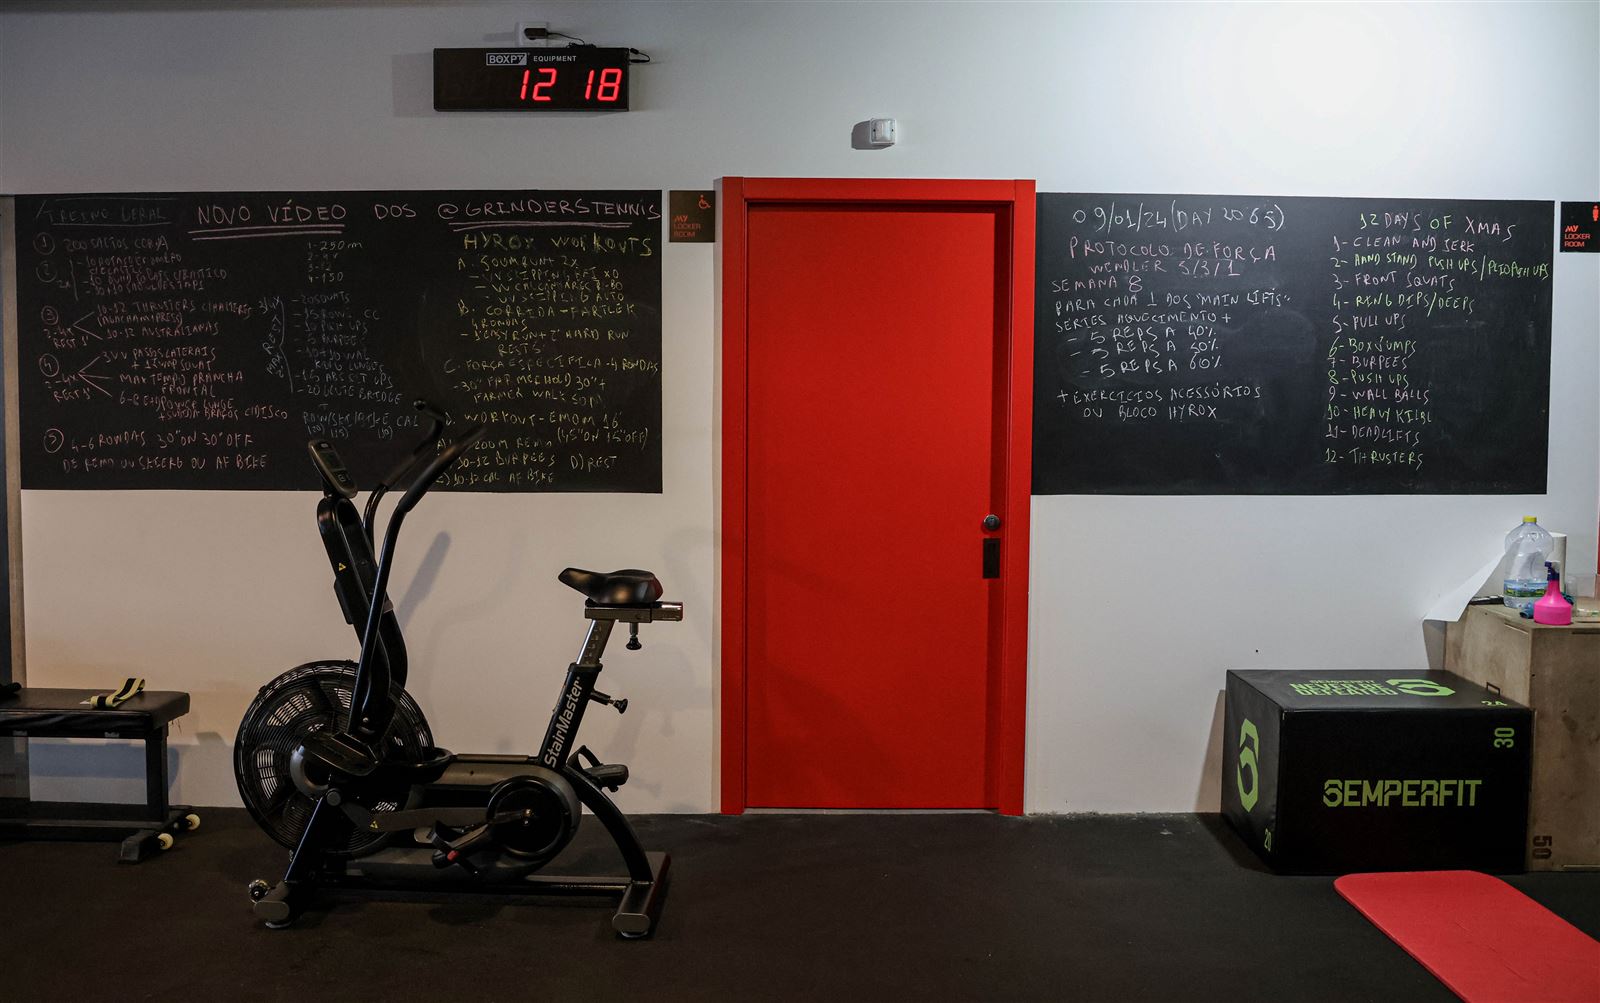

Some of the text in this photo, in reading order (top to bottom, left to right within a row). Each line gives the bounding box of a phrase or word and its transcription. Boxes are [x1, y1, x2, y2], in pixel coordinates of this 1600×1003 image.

[487, 53, 527, 65] BOXPT
[519, 68, 622, 101] 12 18
[198, 198, 661, 224] NOVO VÍDEO DOS @GRINDERSTENNIS
[1360, 212, 1516, 242] 12 DAYS OF XMAS
[463, 231, 652, 256] HYROX WORKOUTS
[1070, 236, 1276, 263] PROTOCOLO DE FORÇA
[1353, 236, 1401, 247] CLEAN
[1412, 237, 1437, 252] AND
[1444, 240, 1475, 253] JERK
[1090, 259, 1167, 274] WENDLER
[1386, 252, 1417, 270] STAND
[1429, 255, 1453, 271] PUSH
[1051, 275, 1143, 292] SEMANA 8
[1355, 271, 1397, 286] FRONT
[1406, 272, 1456, 293] SQUATS
[1055, 298, 1096, 316] PARA
[1104, 294, 1138, 308] CADA
[1147, 292, 1157, 306] 1
[1167, 292, 1191, 309] DOS
[1355, 292, 1392, 308] RING
[1118, 310, 1217, 324] AQUECIMENTO
[1352, 314, 1379, 330] PULL
[1385, 313, 1406, 330] UPS
[607, 330, 630, 340] RUN
[1091, 332, 1105, 343] 5
[1113, 327, 1157, 341] REPS
[1166, 327, 1175, 337] A
[1116, 340, 1160, 358] REPS
[1166, 340, 1176, 351] A
[1100, 364, 1115, 378] 5
[1121, 358, 1162, 374] REPS
[1168, 360, 1177, 371] A
[1352, 355, 1407, 370] BURPEES
[193, 371, 243, 385] PRANCHA
[1351, 369, 1383, 385] PUSH
[1388, 373, 1409, 390] UPS
[1171, 382, 1262, 401] ACESSÓRIOS
[1352, 388, 1388, 400] WALL
[1394, 389, 1429, 405] BALLS
[1083, 404, 1217, 422] OU BLOCO HYROX
[1353, 405, 1391, 422] HEAVY
[1352, 424, 1420, 447] DEADLIFTS
[1349, 447, 1423, 470] THRUSTERS
[544, 679, 583, 768] StairMaster
[1493, 727, 1515, 748] 30
[1322, 779, 1482, 807] SEMPERFIT
[1532, 835, 1552, 860] 50
